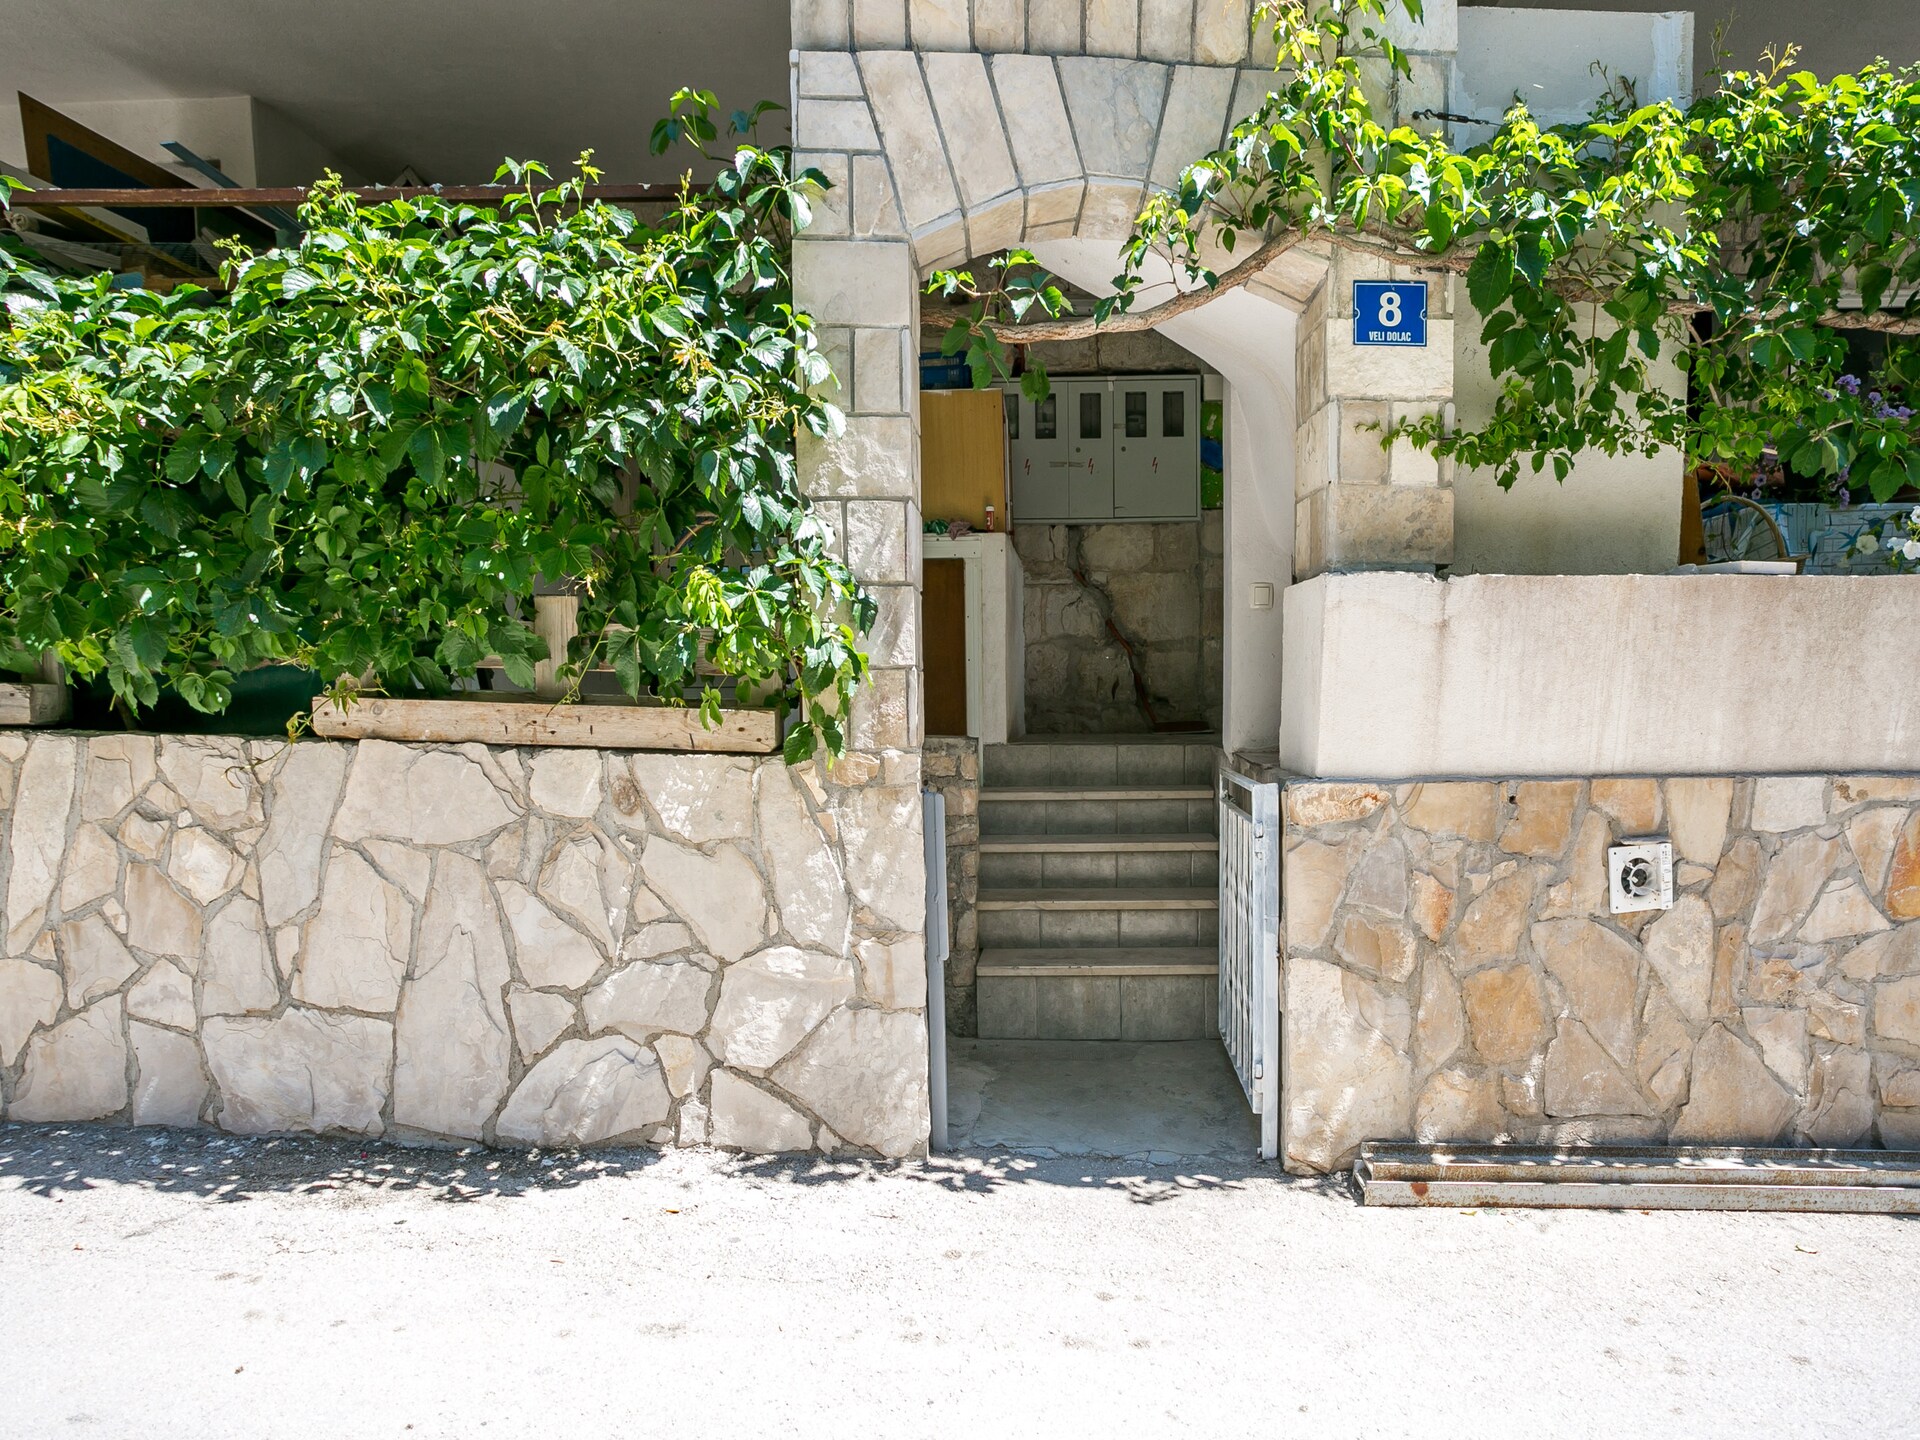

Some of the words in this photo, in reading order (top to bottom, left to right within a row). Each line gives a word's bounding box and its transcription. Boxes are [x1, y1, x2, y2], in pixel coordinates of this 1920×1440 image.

[1378, 291, 1402, 327] 8
[1368, 331, 1385, 341] VELI
[1386, 331, 1412, 342] DOLAC
